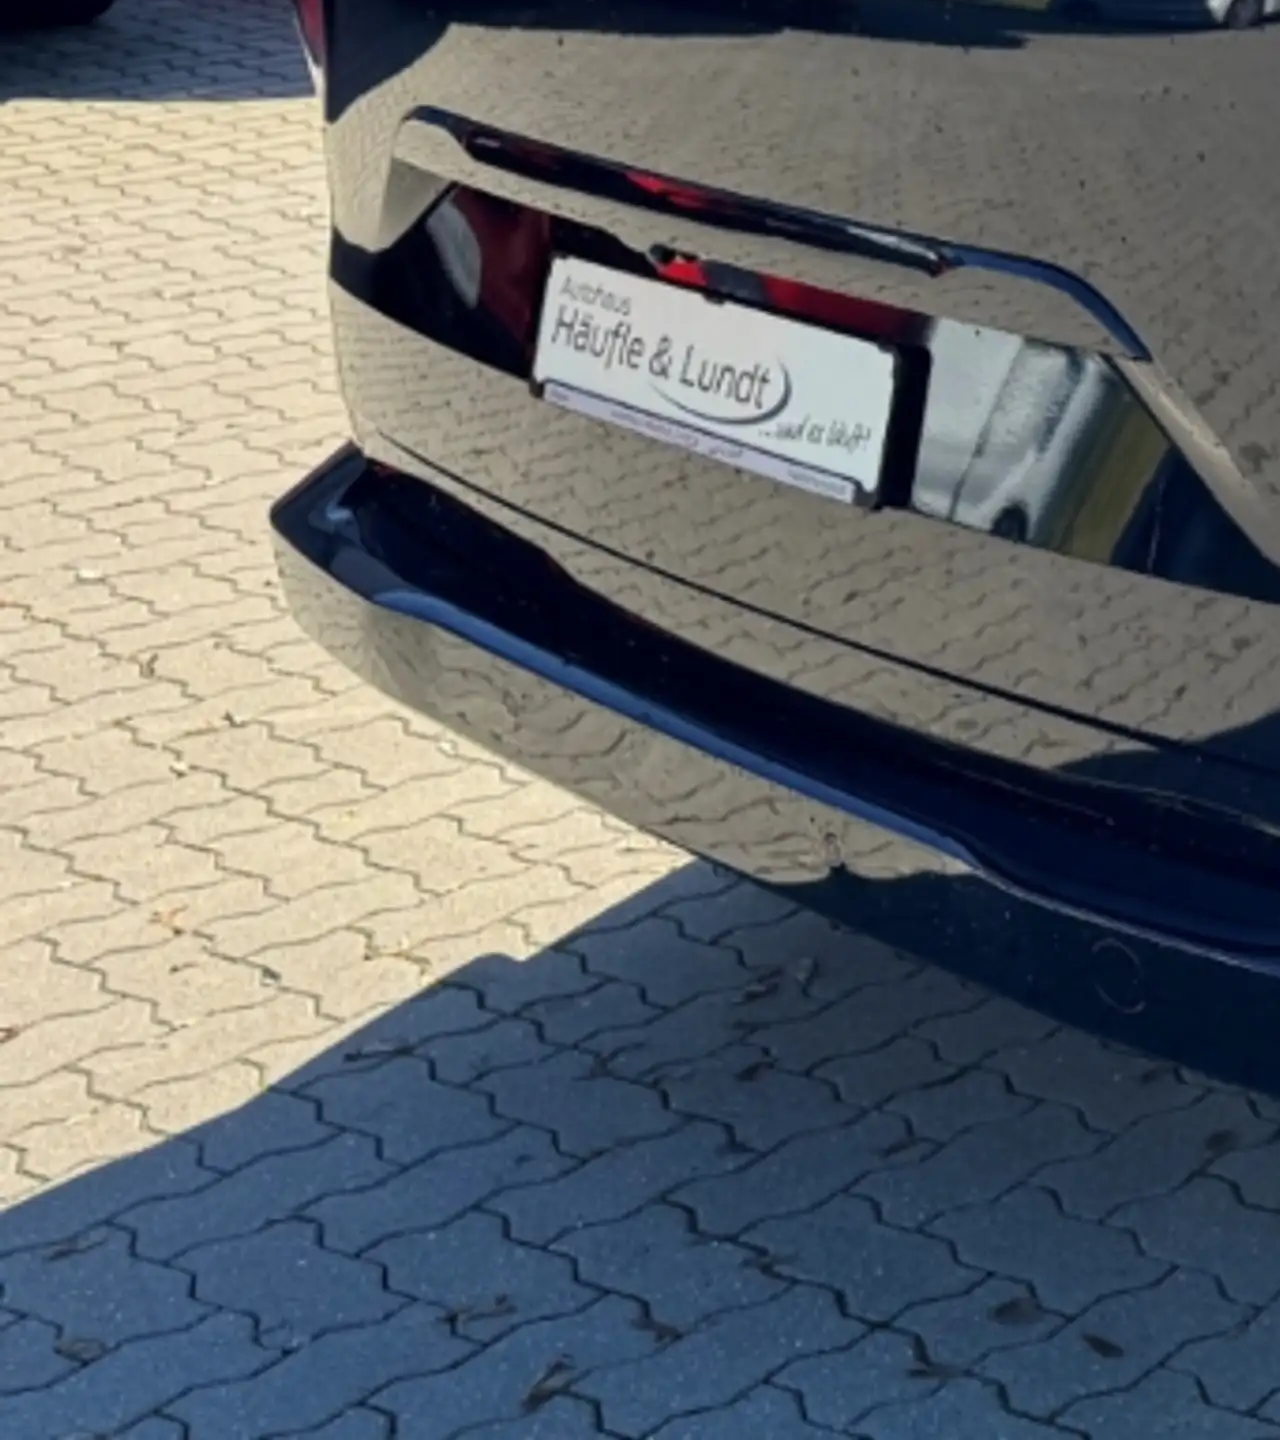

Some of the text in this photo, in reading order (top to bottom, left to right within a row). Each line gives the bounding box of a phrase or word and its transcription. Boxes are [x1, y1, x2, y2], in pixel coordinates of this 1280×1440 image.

[558, 275, 633, 317] Autohaus
[551, 303, 772, 410] Häufle & Lundt
